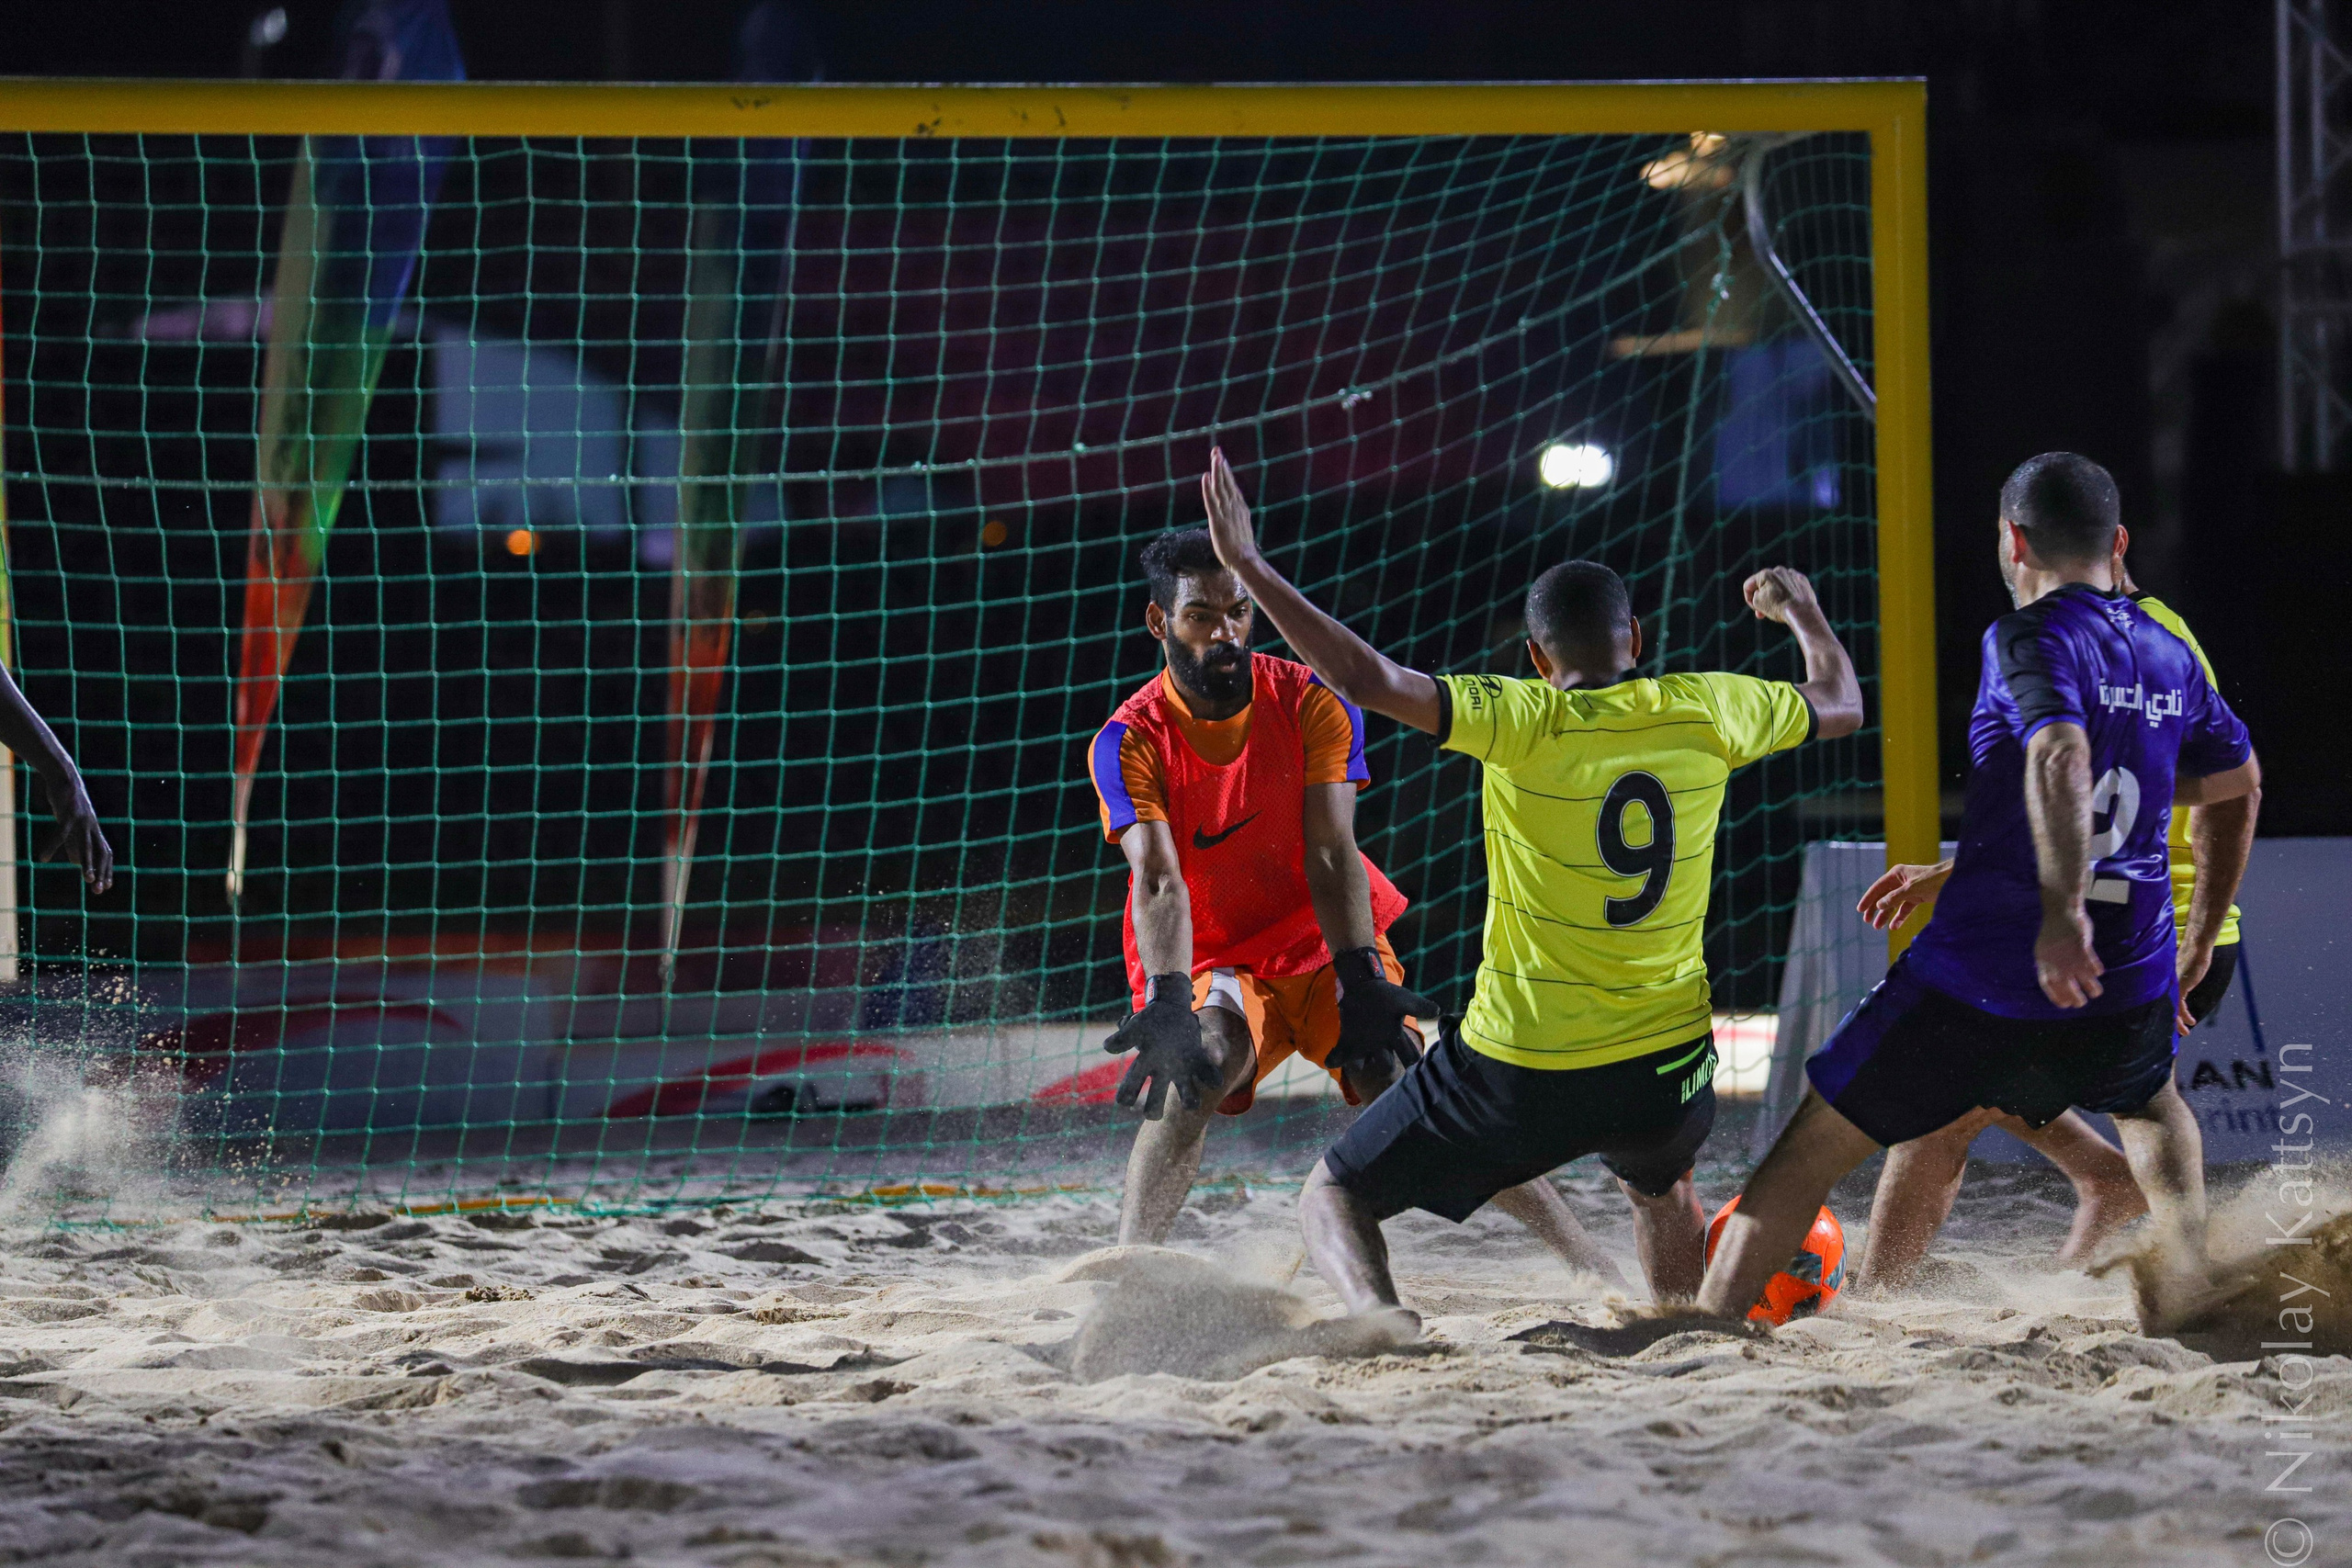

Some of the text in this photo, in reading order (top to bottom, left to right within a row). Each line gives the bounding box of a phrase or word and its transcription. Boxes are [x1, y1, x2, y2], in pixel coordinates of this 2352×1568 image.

[2145, 689, 2183, 728] نادي
[1595, 770, 1676, 928] 9
[2084, 766, 2141, 905] 2
